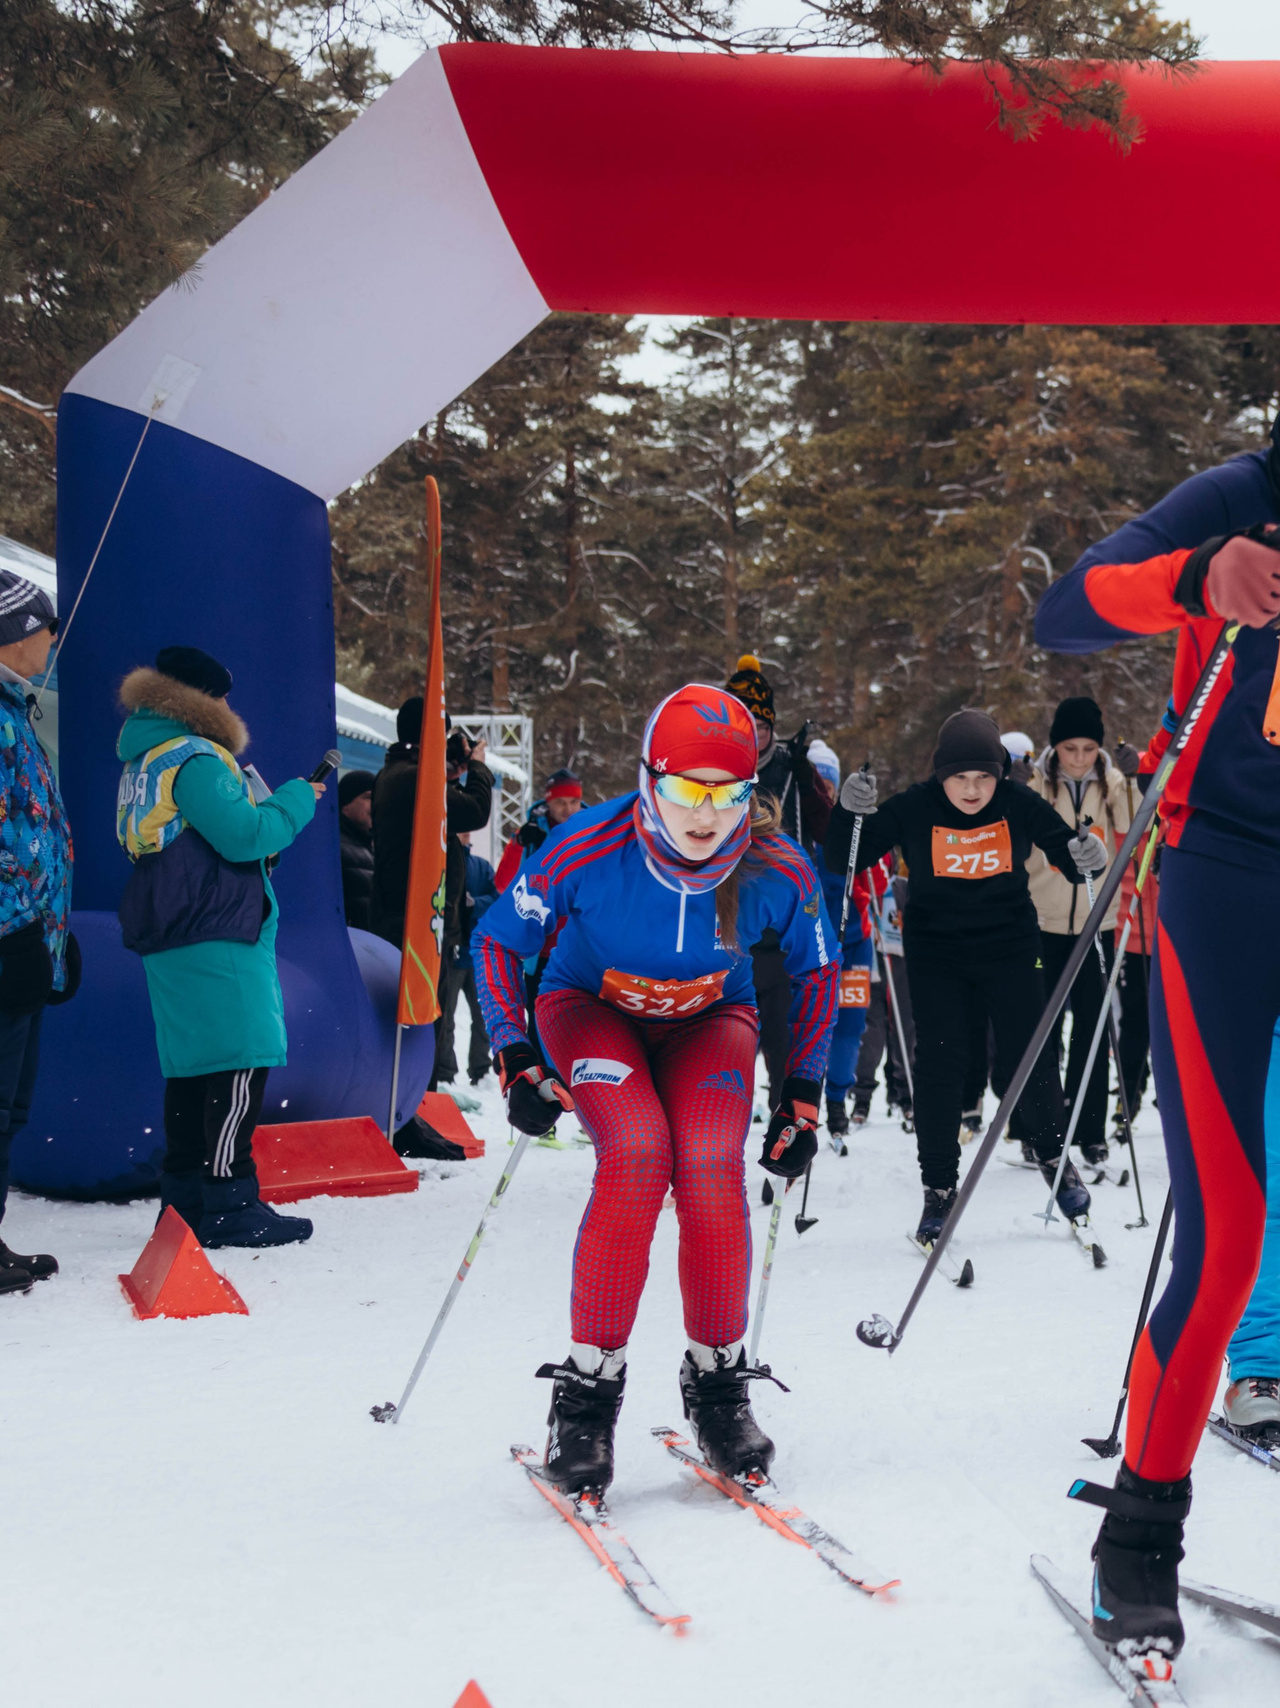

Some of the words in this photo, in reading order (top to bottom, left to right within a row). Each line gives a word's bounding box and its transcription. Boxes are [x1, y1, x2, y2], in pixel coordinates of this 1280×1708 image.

[961, 831, 997, 845] Goodline
[945, 849, 1000, 874] 275
[616, 989, 707, 1017] 324
[583, 1072, 622, 1084] GAZPROM
[552, 1368, 598, 1389] SPINE
